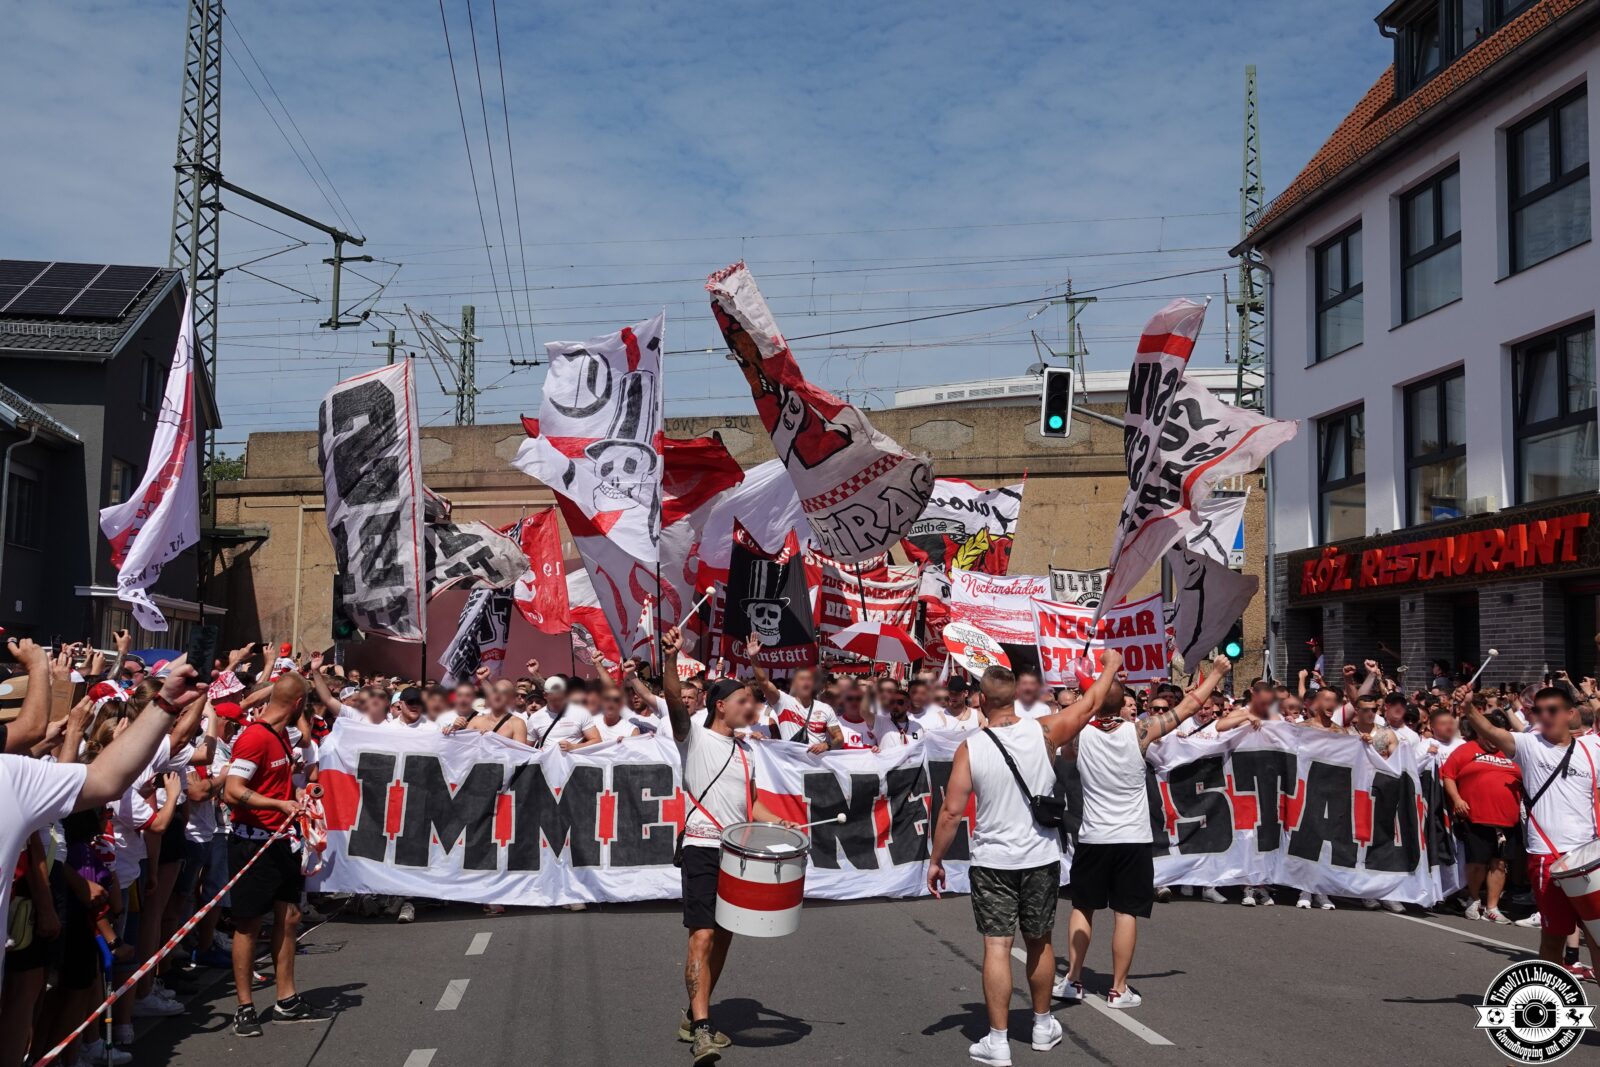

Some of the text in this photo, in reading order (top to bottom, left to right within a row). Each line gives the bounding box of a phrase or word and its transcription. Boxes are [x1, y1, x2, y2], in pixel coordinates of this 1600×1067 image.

[1301, 513, 1590, 595] KÖZ RESTAURANT
[961, 574, 1047, 598] Neckarstadion
[825, 600, 852, 620] DIE
[1038, 609, 1157, 640] NECKAR
[732, 640, 809, 664] Canstatt
[348, 750, 677, 872] IMME
